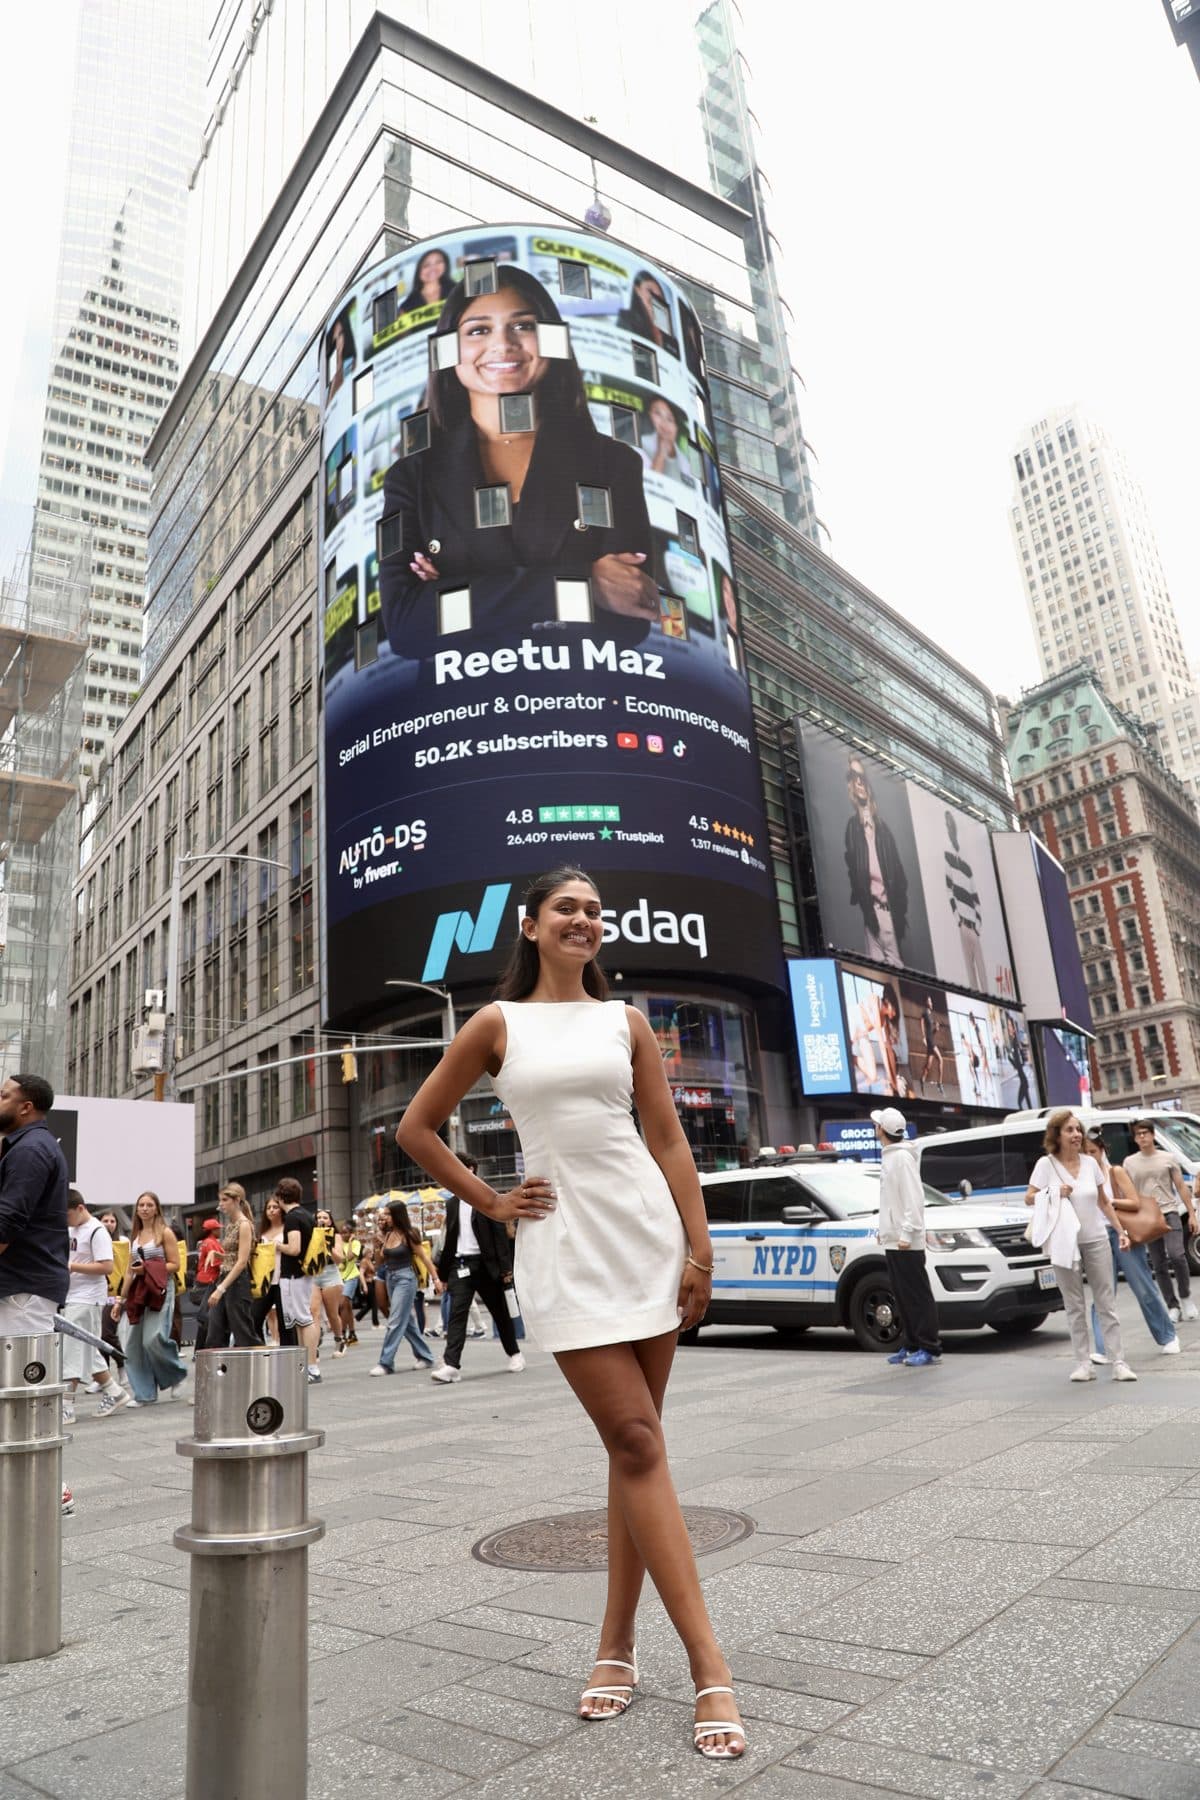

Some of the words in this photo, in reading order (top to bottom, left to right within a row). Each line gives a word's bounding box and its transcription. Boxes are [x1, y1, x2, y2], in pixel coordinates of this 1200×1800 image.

[535, 239, 577, 257] QUIT
[435, 639, 570, 685] Reetu
[582, 639, 666, 680] Maz
[339, 734, 370, 767] Serial
[373, 702, 489, 747] Entrepreneur
[494, 697, 509, 714] &
[514, 693, 606, 714] Operator
[625, 696, 719, 733] Ecommerce
[720, 724, 751, 754] expert
[414, 739, 473, 768] 50.2K
[476, 730, 609, 755] subscribers
[505, 808, 534, 825] 4.8
[688, 814, 709, 831] 4.5
[507, 831, 548, 846] 26,409
[551, 830, 596, 843] reviews
[615, 830, 665, 844] Trustpilot
[712, 842, 740, 859] reviews
[353, 876, 364, 889] by
[518, 898, 708, 960] sdaq
[467, 1120, 506, 1133] branded
[841, 1128, 875, 1140] GROCE
[753, 1245, 817, 1276] NYPD
